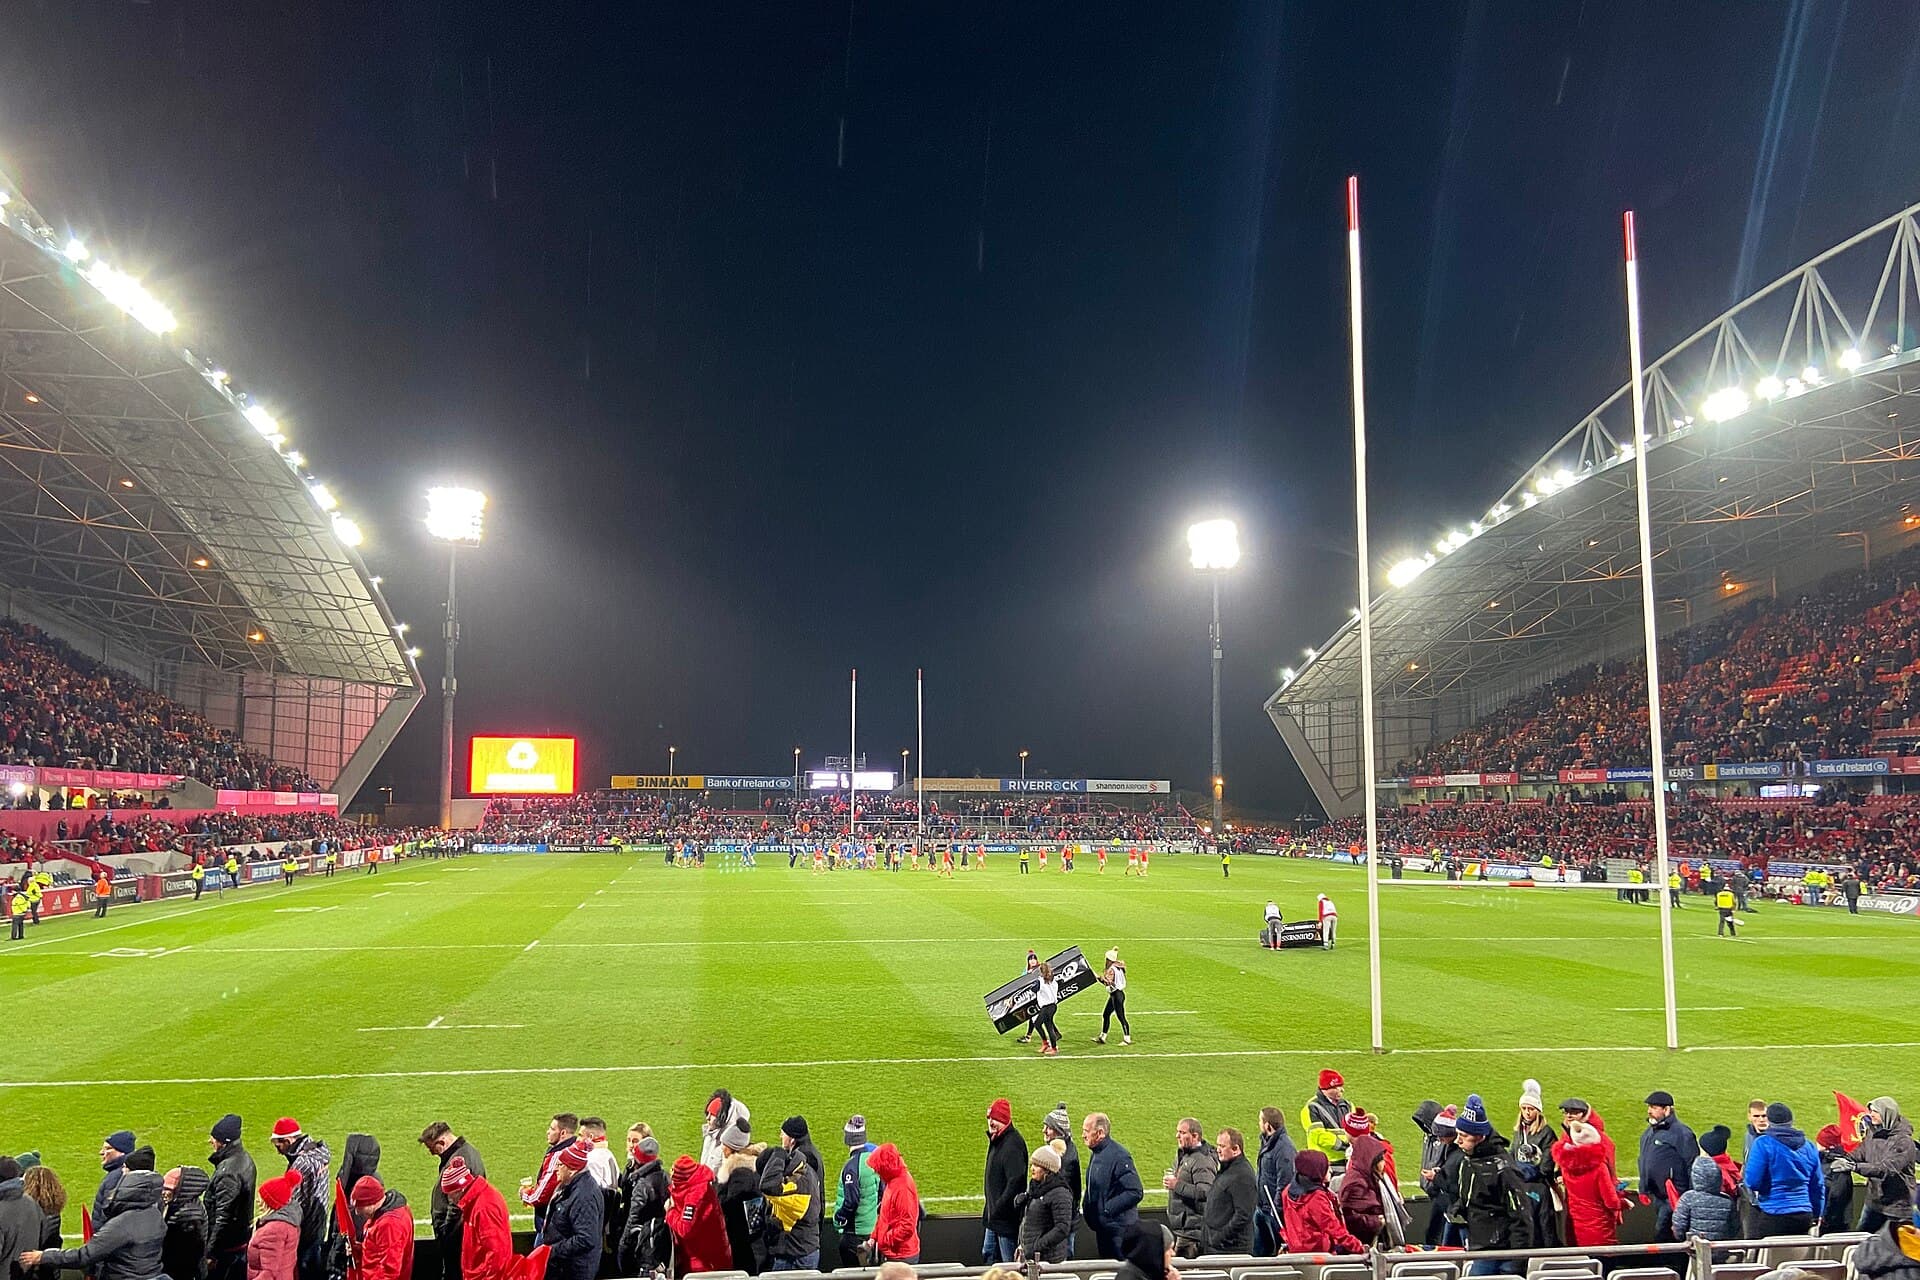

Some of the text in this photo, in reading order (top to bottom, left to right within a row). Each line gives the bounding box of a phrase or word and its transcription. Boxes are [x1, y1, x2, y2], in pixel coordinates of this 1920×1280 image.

[1720, 767, 1736, 775] Bank
[1745, 766, 1767, 774] Ireland
[1816, 764, 1837, 773] Bank
[1846, 762, 1872, 772] Ireland
[636, 777, 689, 788] BINMAN
[707, 778, 775, 788] Bank of Ireland
[1008, 780, 1079, 791] RIVERROCK
